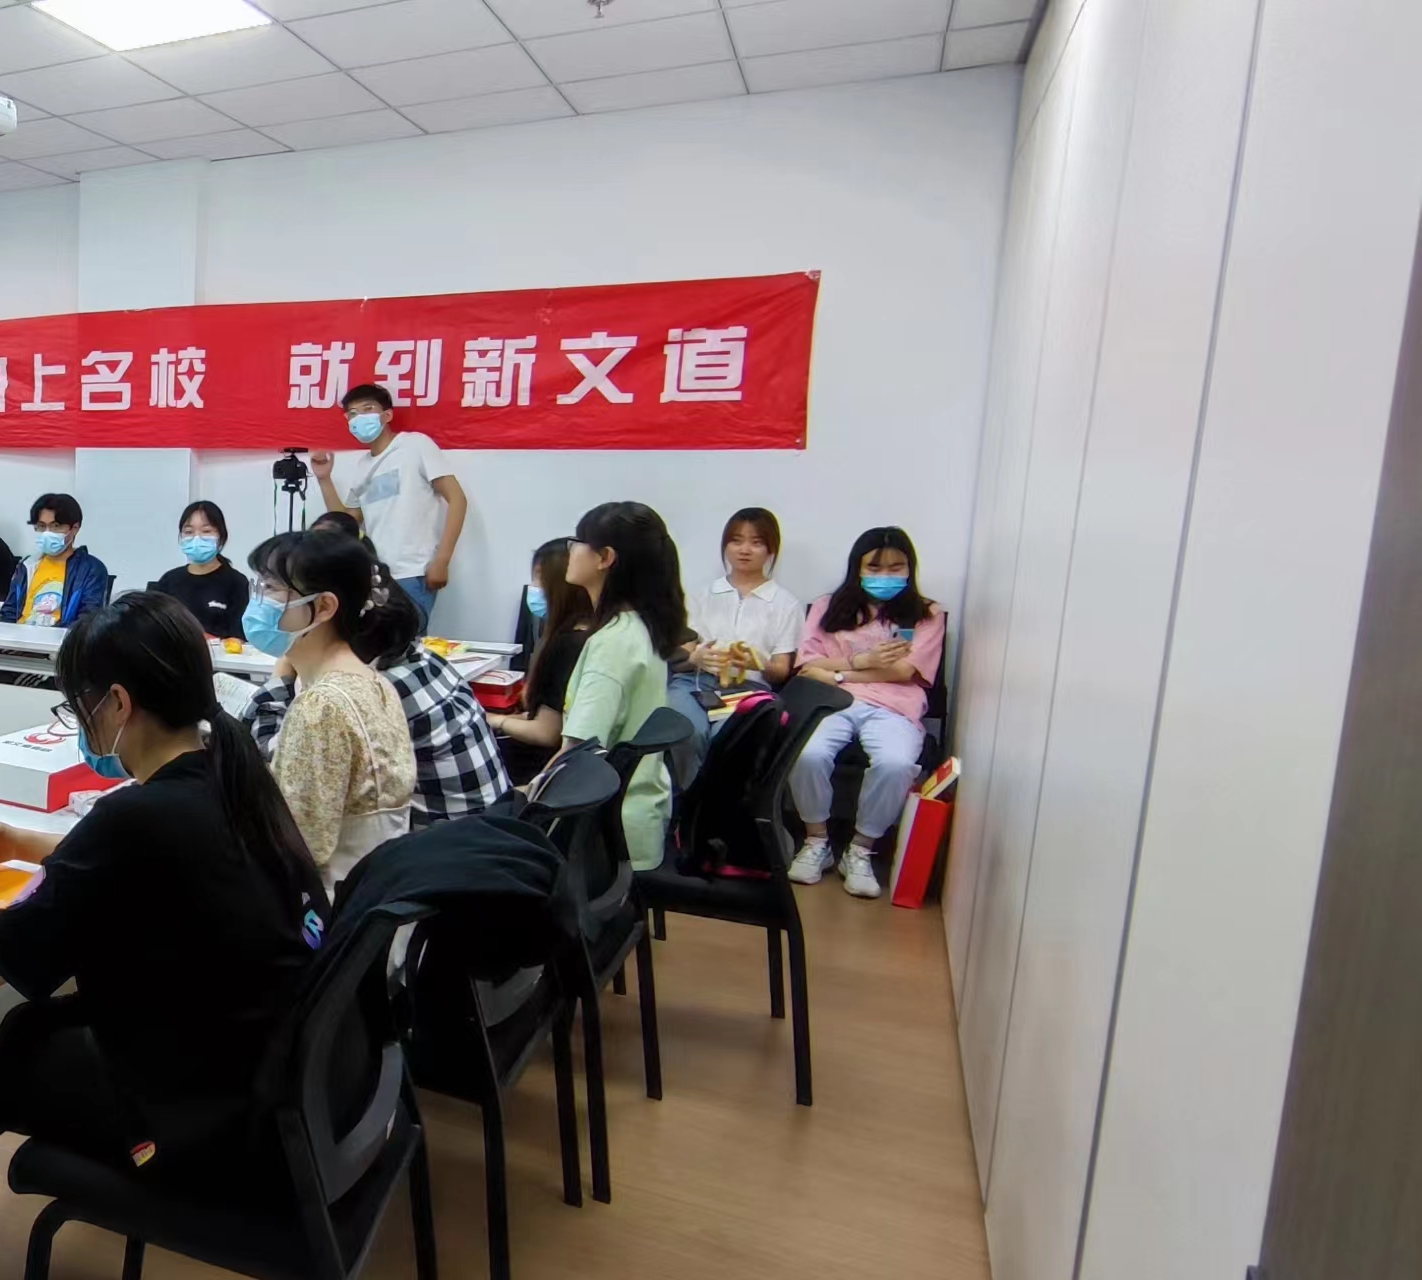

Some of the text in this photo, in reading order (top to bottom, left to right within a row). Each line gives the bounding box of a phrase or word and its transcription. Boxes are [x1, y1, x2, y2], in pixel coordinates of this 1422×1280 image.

[287, 325, 748, 409] 就到新文道
